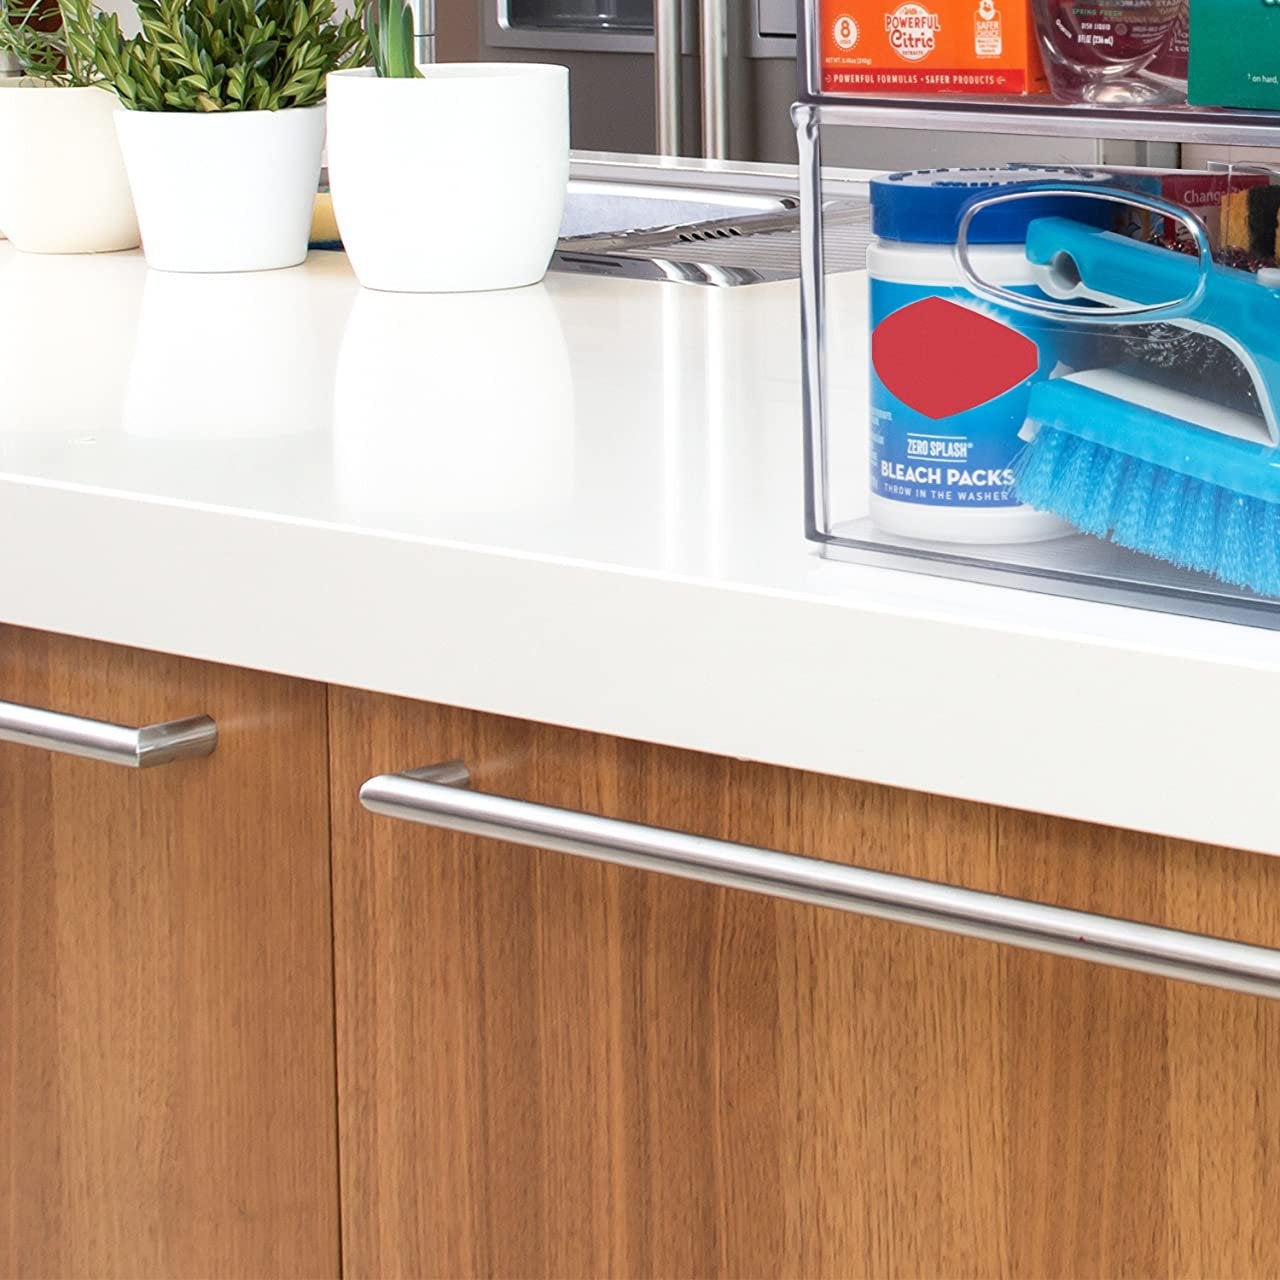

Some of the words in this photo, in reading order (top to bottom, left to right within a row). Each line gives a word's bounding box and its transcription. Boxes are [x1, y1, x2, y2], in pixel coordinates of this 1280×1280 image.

[840, 19, 851, 38] 8
[886, 15, 940, 30] POWERFUL
[890, 29, 934, 49] Citric
[833, 73, 875, 84] POWERFUL
[877, 74, 918, 84] FORMULAS
[925, 75, 950, 84] SAFER
[953, 75, 995, 85] PRODUCTS
[1262, 75, 1279, 85] hard,
[907, 438, 928, 456] ZERO
[880, 460, 942, 485] BLEACH
[947, 467, 1016, 487] PACKS
[884, 482, 912, 496] THROW
[915, 489, 927, 498] IN
[931, 490, 952, 500] THE
[958, 491, 1009, 501] WASHER
